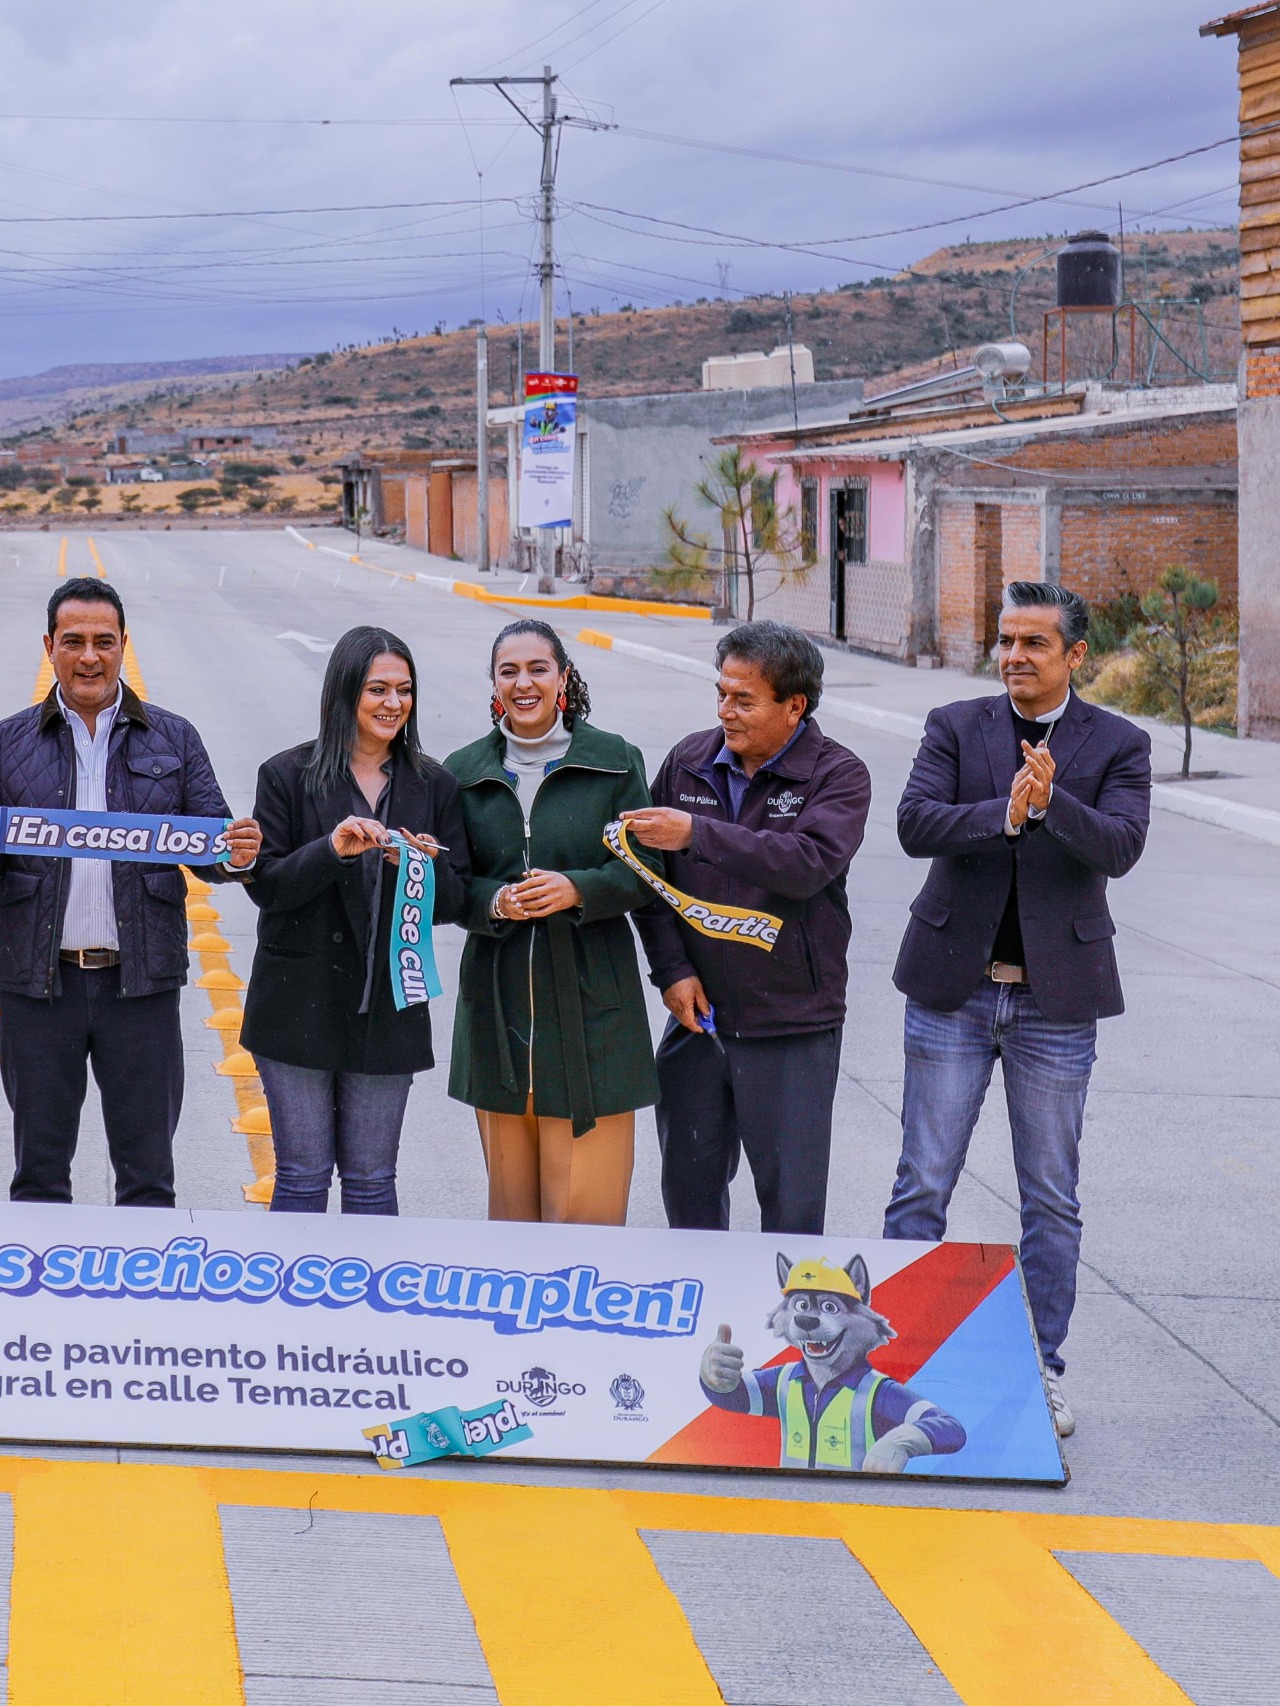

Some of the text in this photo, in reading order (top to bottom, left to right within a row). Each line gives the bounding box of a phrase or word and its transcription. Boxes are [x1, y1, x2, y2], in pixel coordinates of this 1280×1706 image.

[6, 815, 60, 847] ¡En
[65, 823, 150, 852] casa
[155, 823, 207, 854] los
[400, 903, 422, 945] se
[44, 1240, 278, 1293] sueños
[293, 1258, 368, 1298] se
[383, 1265, 698, 1330] cumplen!
[3, 1334, 53, 1362] de
[63, 1338, 267, 1371] pavimento
[276, 1344, 469, 1379] hidráulico
[65, 1377, 113, 1400] en
[123, 1374, 220, 1403] calle
[227, 1377, 412, 1411] Temazcal
